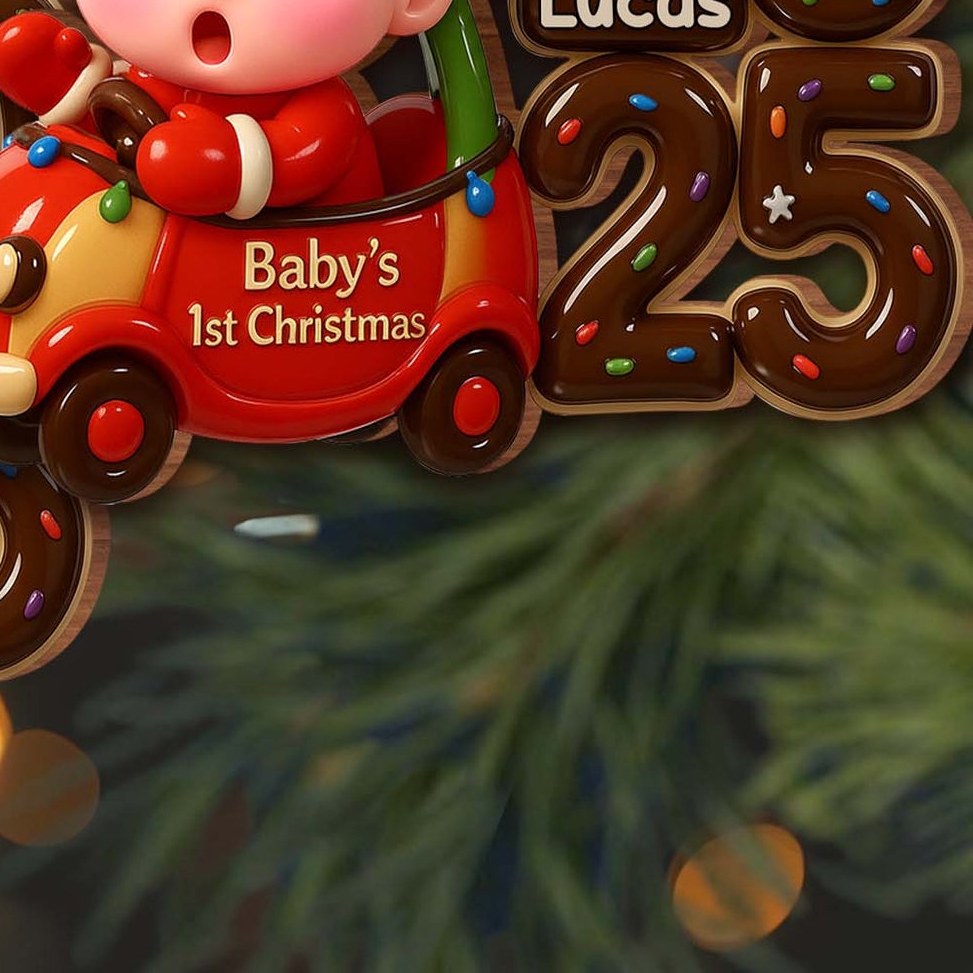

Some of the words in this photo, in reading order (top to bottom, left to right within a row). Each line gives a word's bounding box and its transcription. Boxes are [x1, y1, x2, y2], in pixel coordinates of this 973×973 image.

[521, 48, 961, 418] 25
[245, 237, 400, 298] Baby’s
[188, 302, 238, 347] 1st
[247, 303, 426, 346] Christmas
